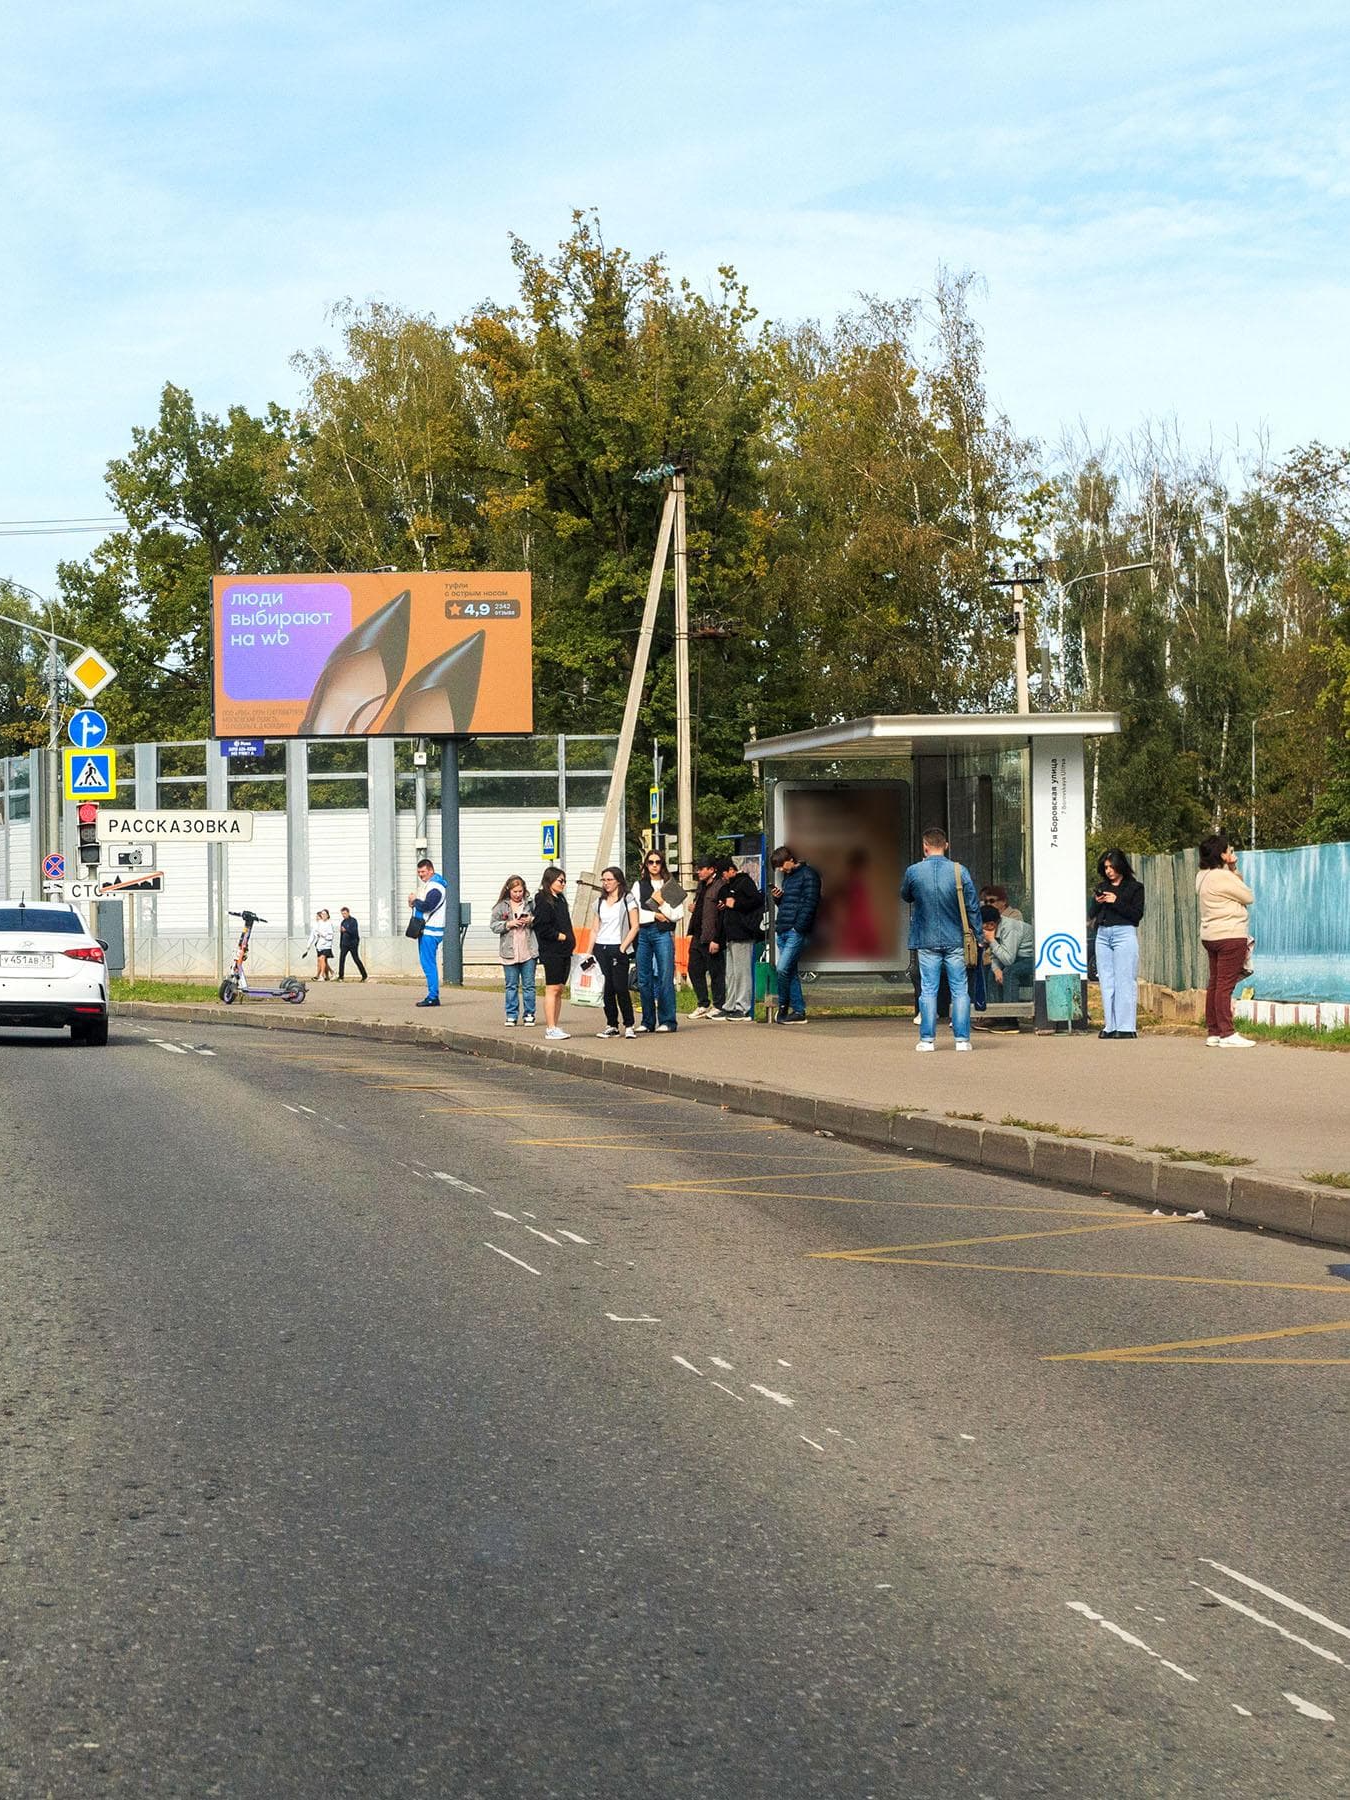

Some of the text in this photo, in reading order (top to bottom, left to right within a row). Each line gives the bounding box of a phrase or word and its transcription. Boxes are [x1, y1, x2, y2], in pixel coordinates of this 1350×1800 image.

[231, 592, 283, 607] люди
[464, 603, 491, 617] 4,9
[231, 610, 332, 629] выбирают
[231, 629, 289, 646] на wb
[1050, 758, 1059, 784] улица
[1050, 786, 1059, 832] Боровская
[108, 818, 241, 833] РАССКАЗОВКА
[72, 884, 116, 898] СТО
